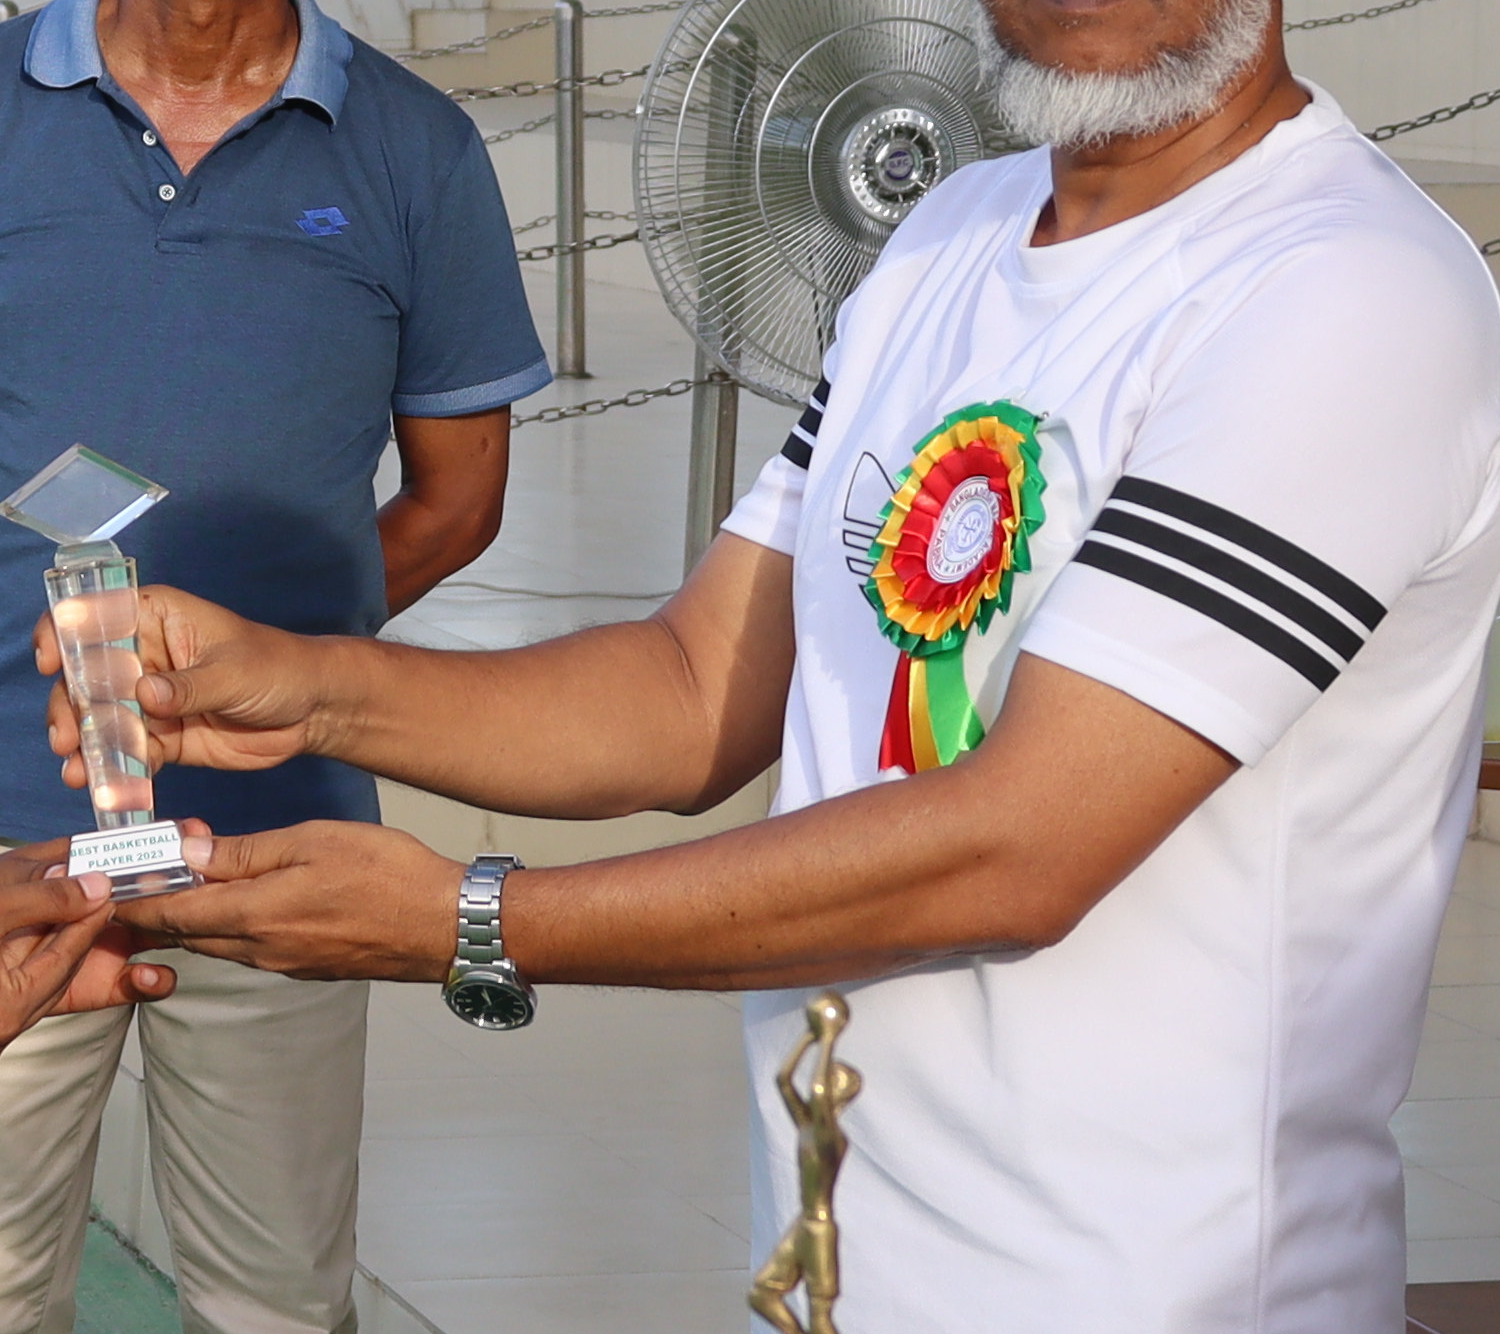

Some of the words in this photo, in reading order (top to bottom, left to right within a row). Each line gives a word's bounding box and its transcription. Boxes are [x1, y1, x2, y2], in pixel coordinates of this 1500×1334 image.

[69, 845, 99, 858] BEST
[103, 832, 179, 852] BASKETBALL
[88, 854, 133, 869] PLAYER
[137, 849, 164, 862] 2023
